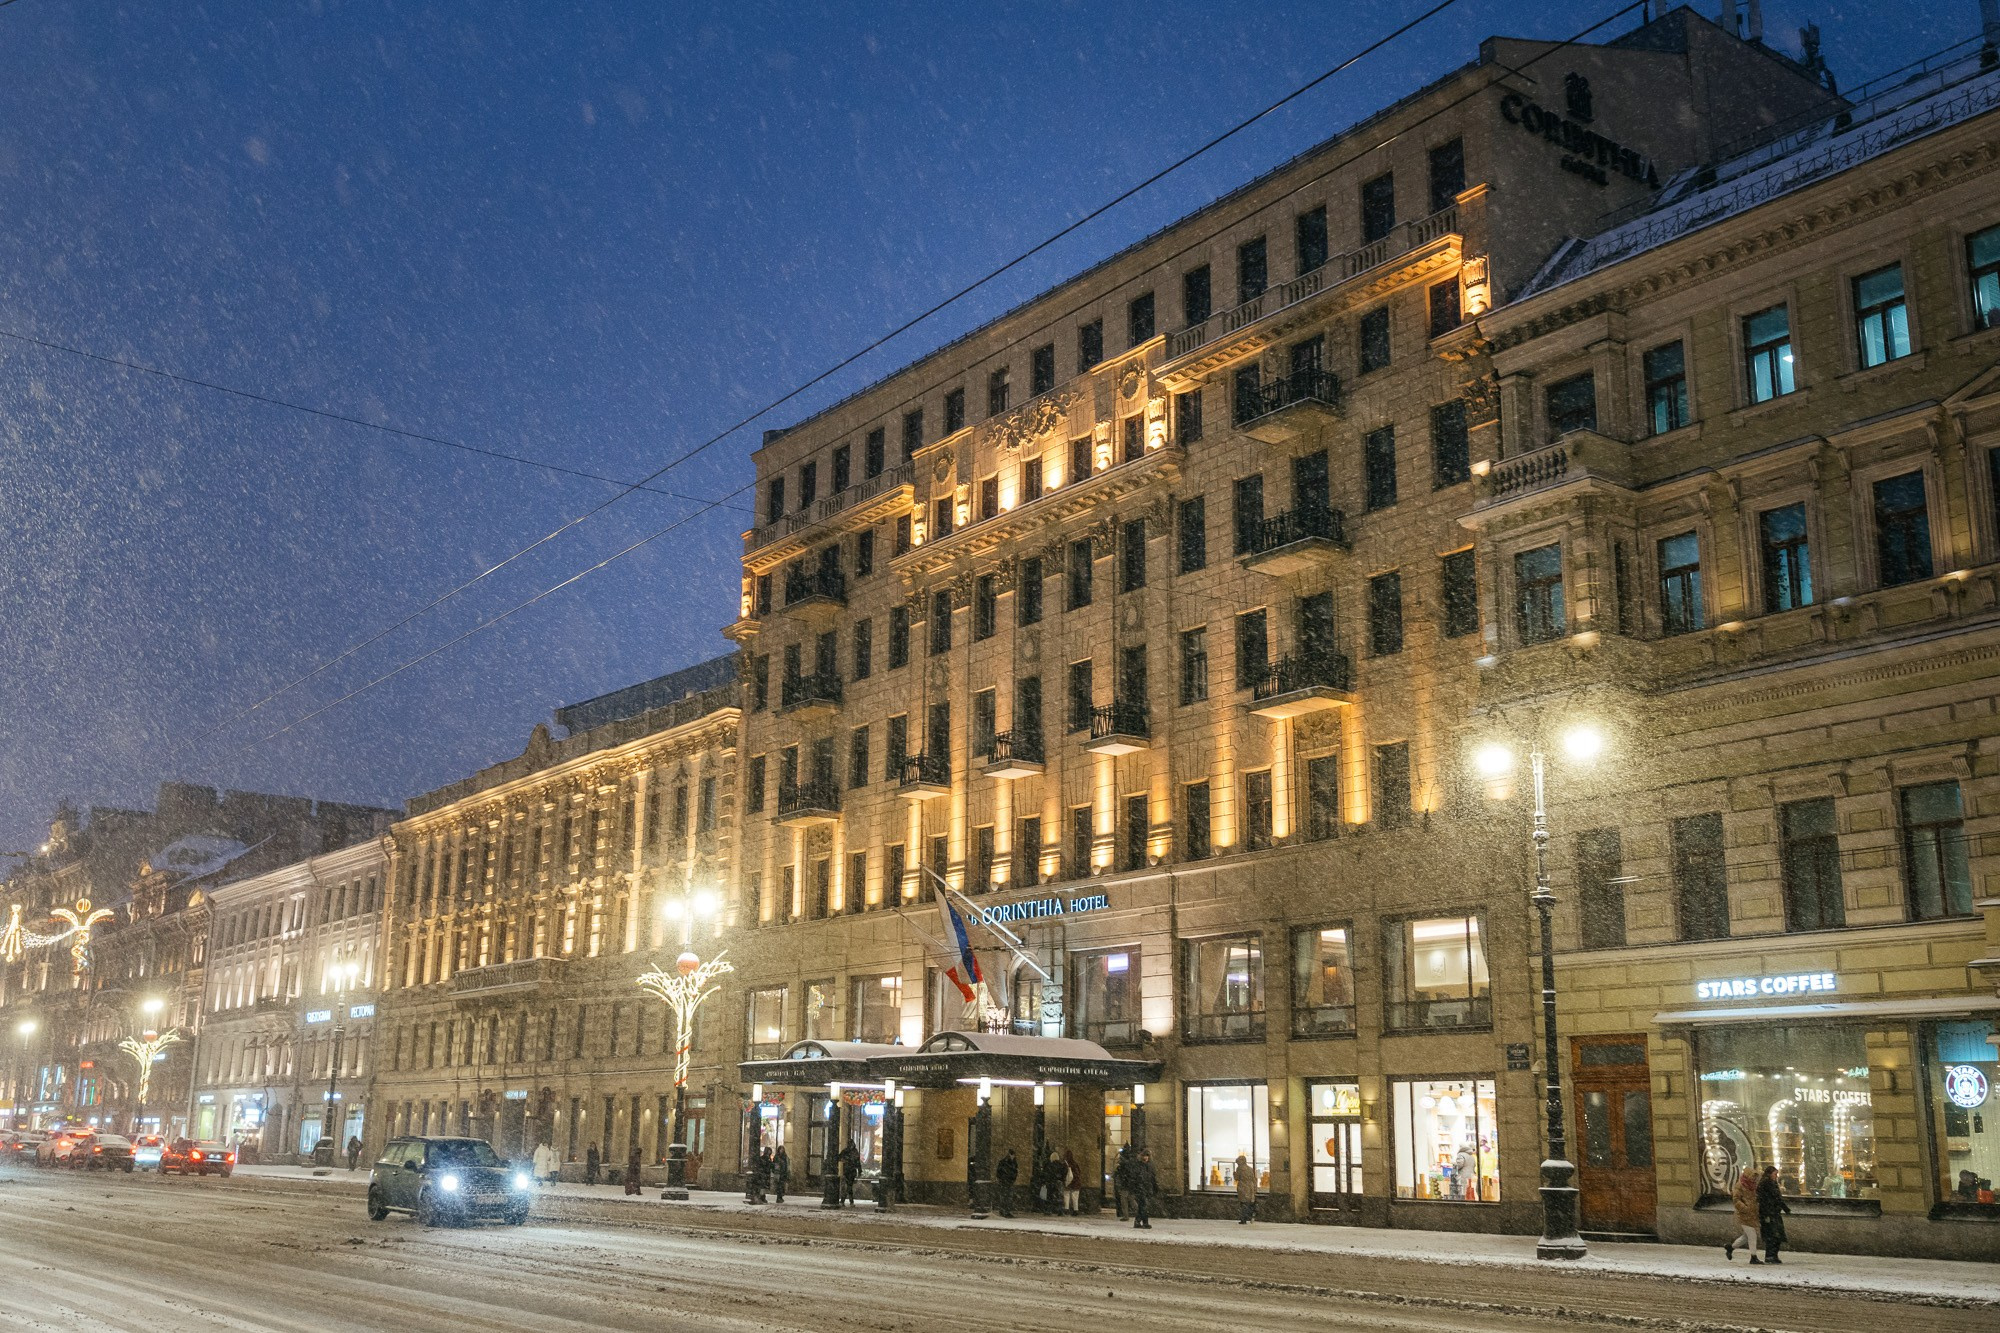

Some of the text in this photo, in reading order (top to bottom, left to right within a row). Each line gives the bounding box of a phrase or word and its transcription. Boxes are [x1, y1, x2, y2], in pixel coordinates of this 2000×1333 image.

[982, 897, 1063, 925] CORINTHIA
[1070, 894, 1109, 913] HOTEL
[1697, 973, 1835, 998] STARS COFFEE
[1950, 1066, 1980, 1079] STARS
[1794, 1087, 1830, 1103] STARS
